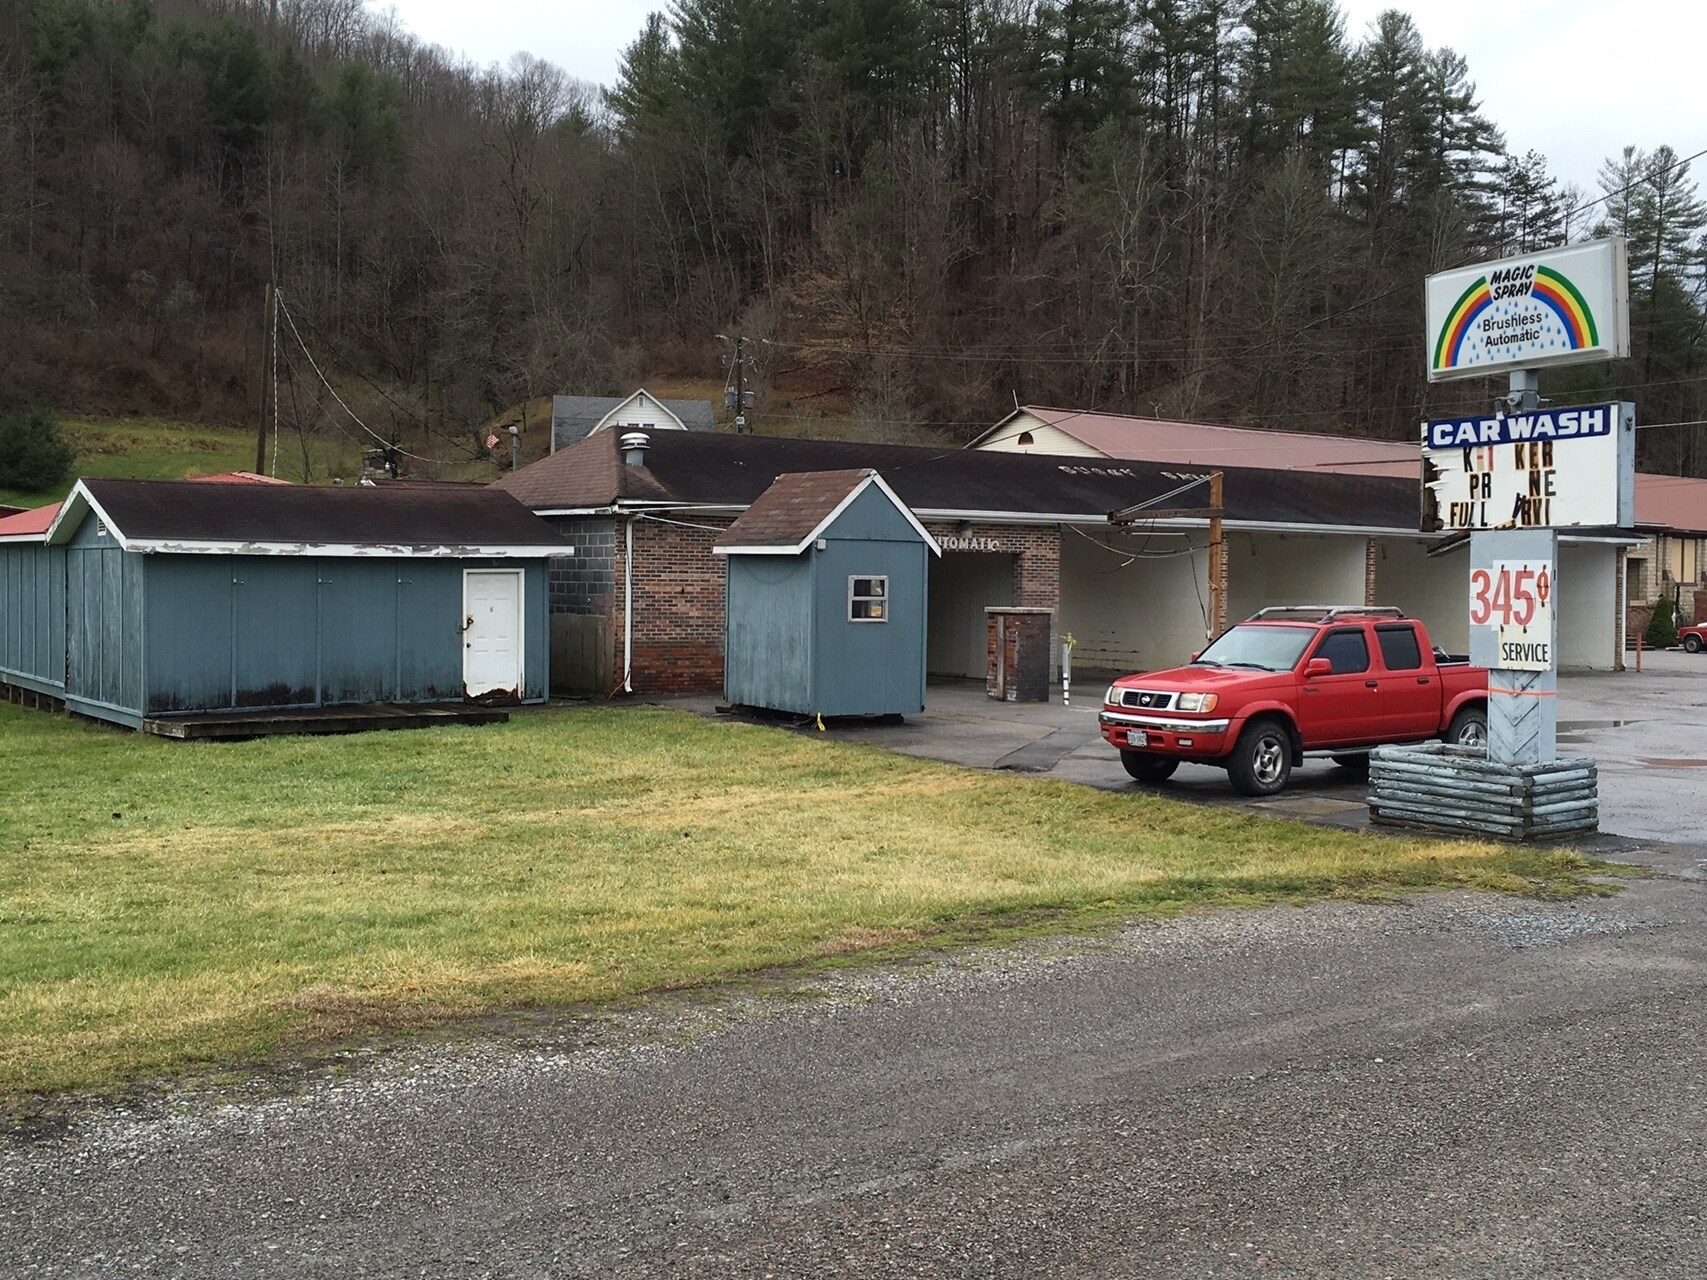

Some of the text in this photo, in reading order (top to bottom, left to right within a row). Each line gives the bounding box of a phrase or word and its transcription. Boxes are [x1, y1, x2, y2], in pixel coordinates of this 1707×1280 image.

[1489, 264, 1535, 286] MAGIC
[1493, 280, 1533, 301] SPRAY
[1483, 313, 1543, 332] Brushless
[1485, 328, 1540, 348] Automatic
[1432, 409, 1604, 446] CAR WASH
[1449, 501, 1488, 527] FULL
[1502, 642, 1549, 663] SERVICE
